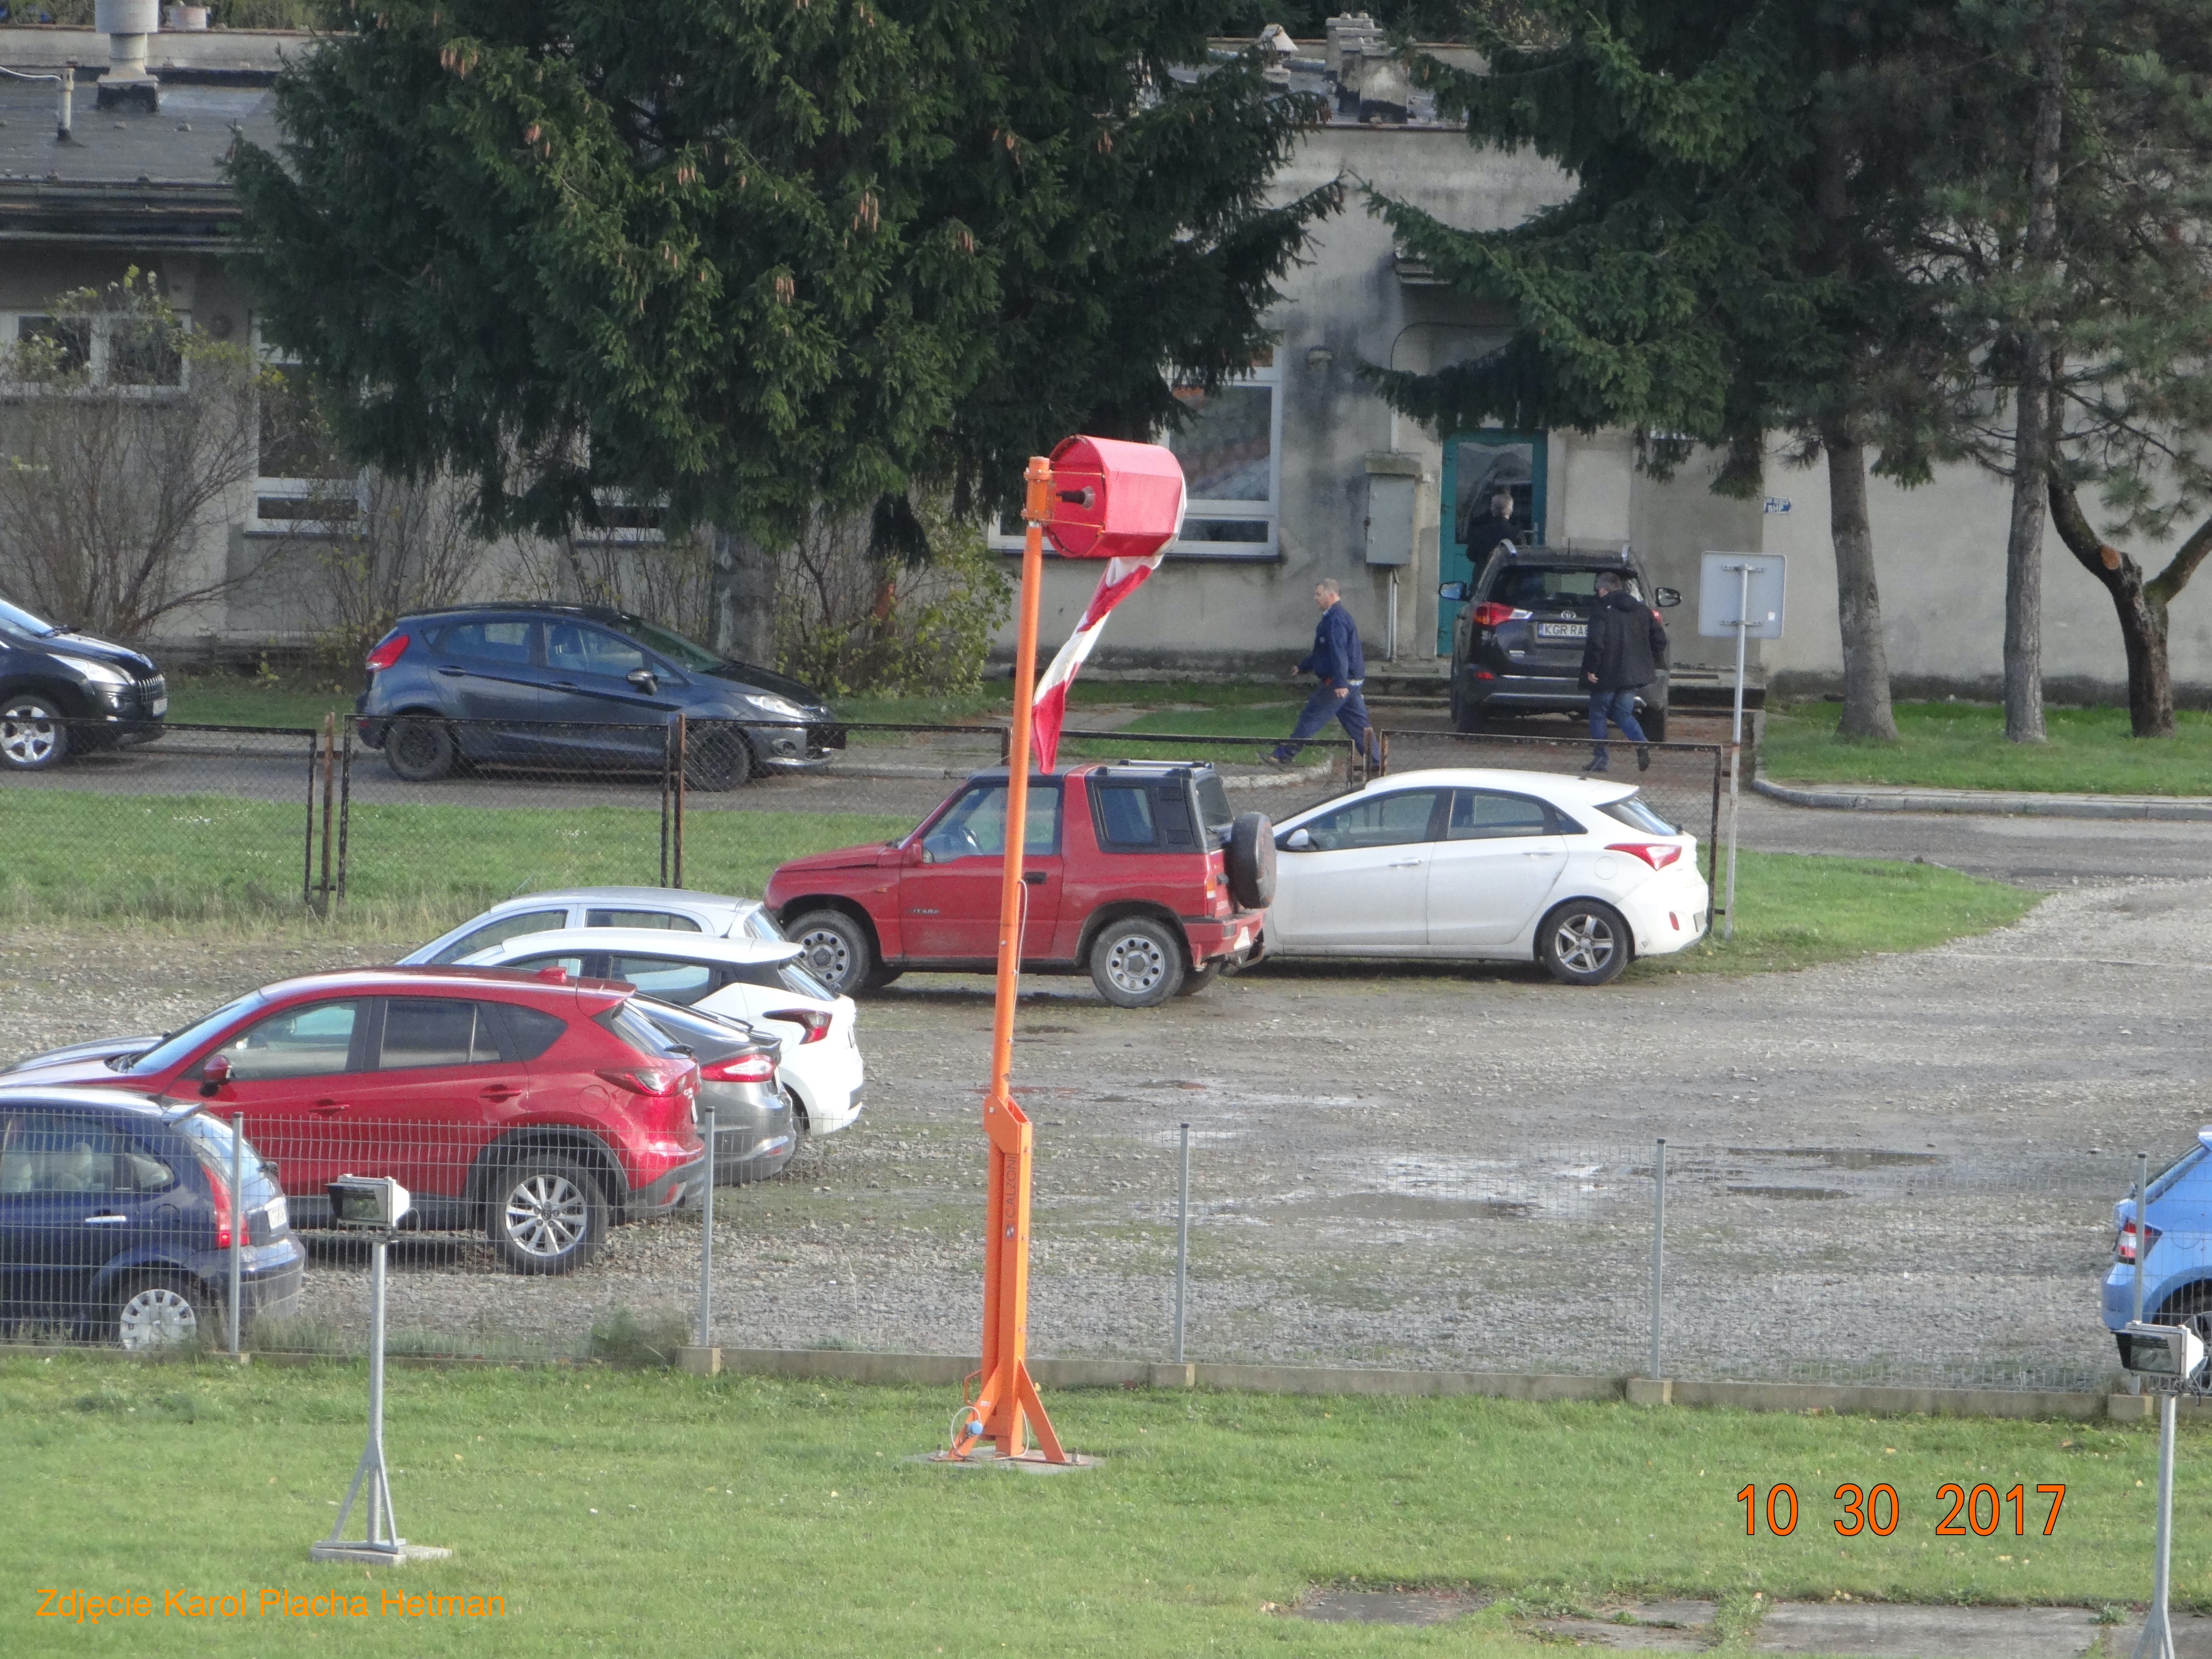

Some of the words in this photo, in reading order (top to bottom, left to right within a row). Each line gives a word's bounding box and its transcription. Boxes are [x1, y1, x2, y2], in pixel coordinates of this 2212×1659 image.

[1767, 504, 1783, 513] BHP
[1545, 624, 1567, 635] KGR
[1005, 1156, 1017, 1218] CALZONI
